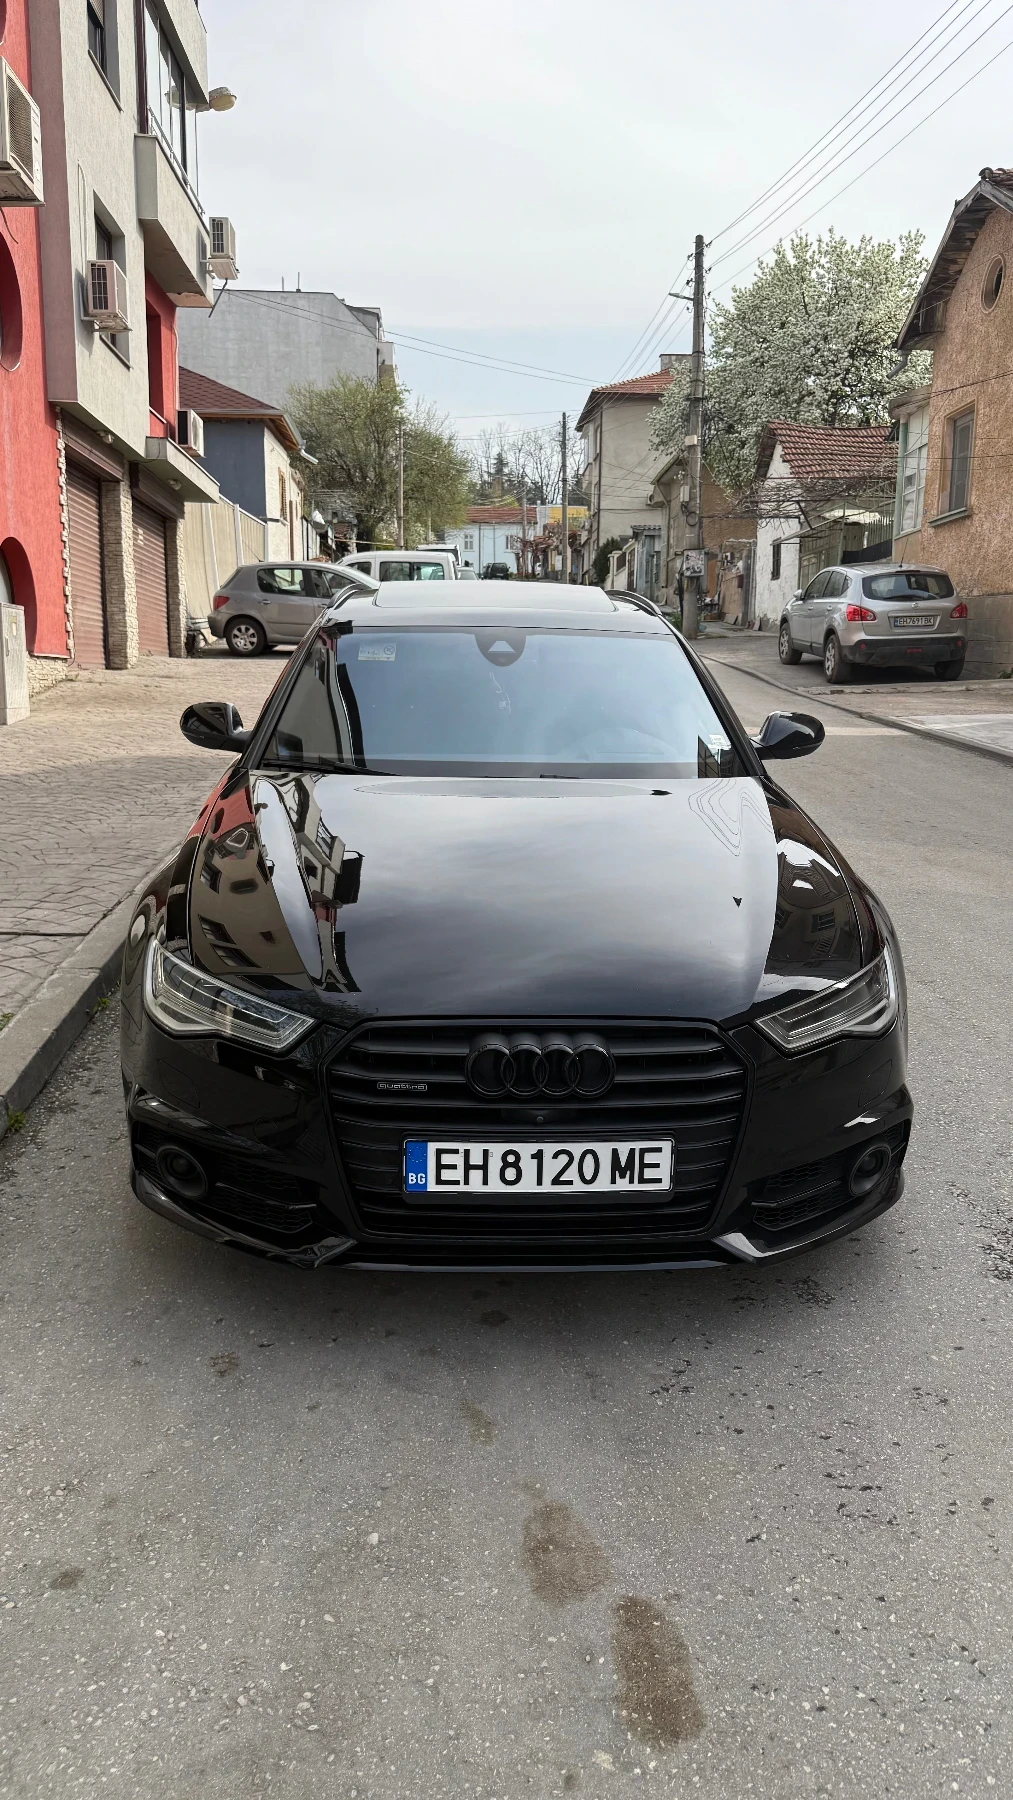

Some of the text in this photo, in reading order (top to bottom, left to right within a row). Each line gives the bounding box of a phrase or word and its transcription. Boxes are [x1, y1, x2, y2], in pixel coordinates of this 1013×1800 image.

[408, 1172, 426, 1185] BG
[435, 1146, 663, 1187] EH 8120 ME
